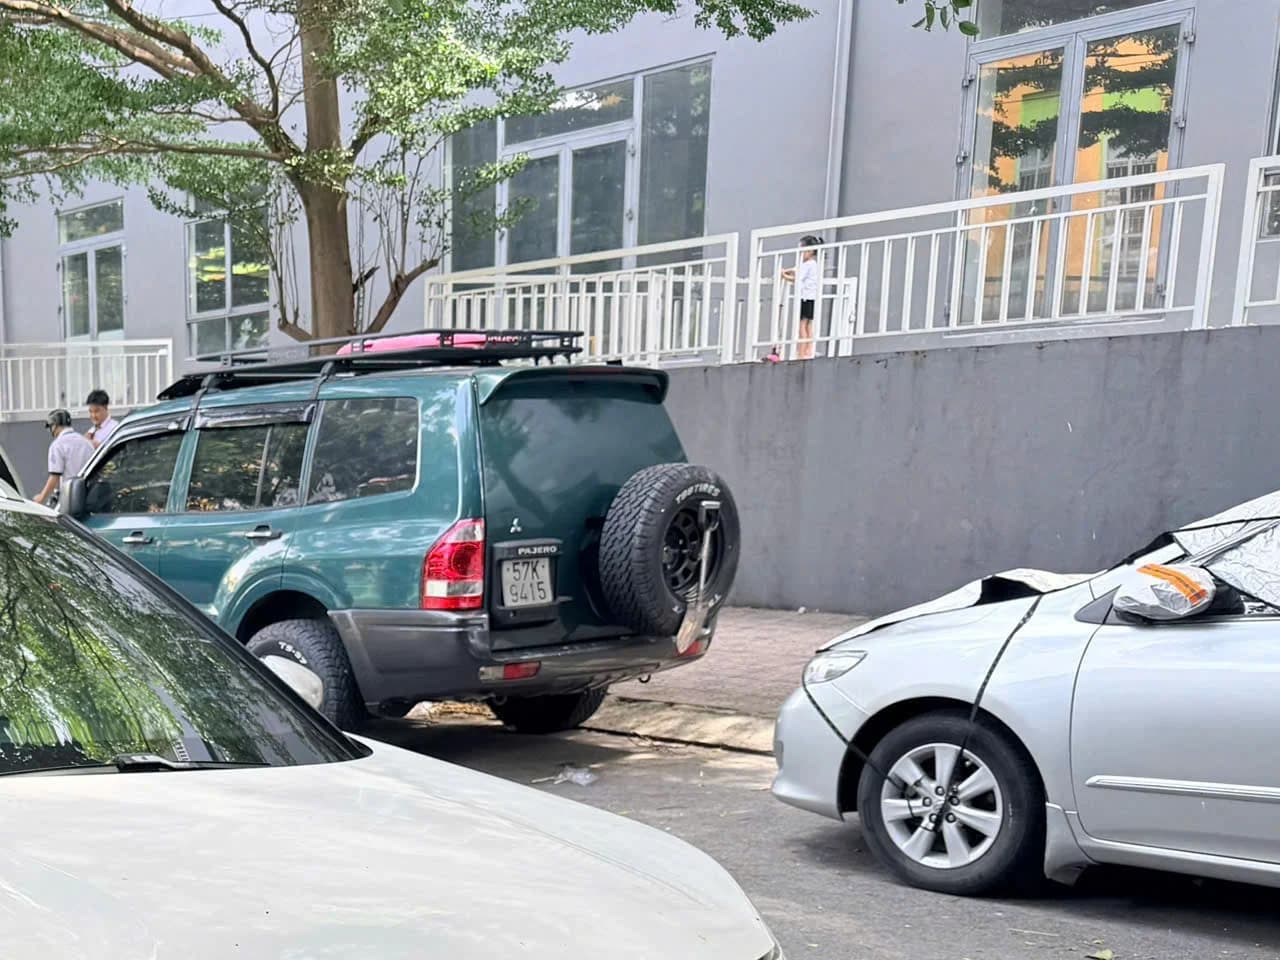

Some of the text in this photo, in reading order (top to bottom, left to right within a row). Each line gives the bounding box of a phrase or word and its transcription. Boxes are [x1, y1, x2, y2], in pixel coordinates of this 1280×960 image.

[518, 545, 557, 555] PAJERO
[512, 560, 539, 581] 57K
[509, 581, 547, 602] 9415
